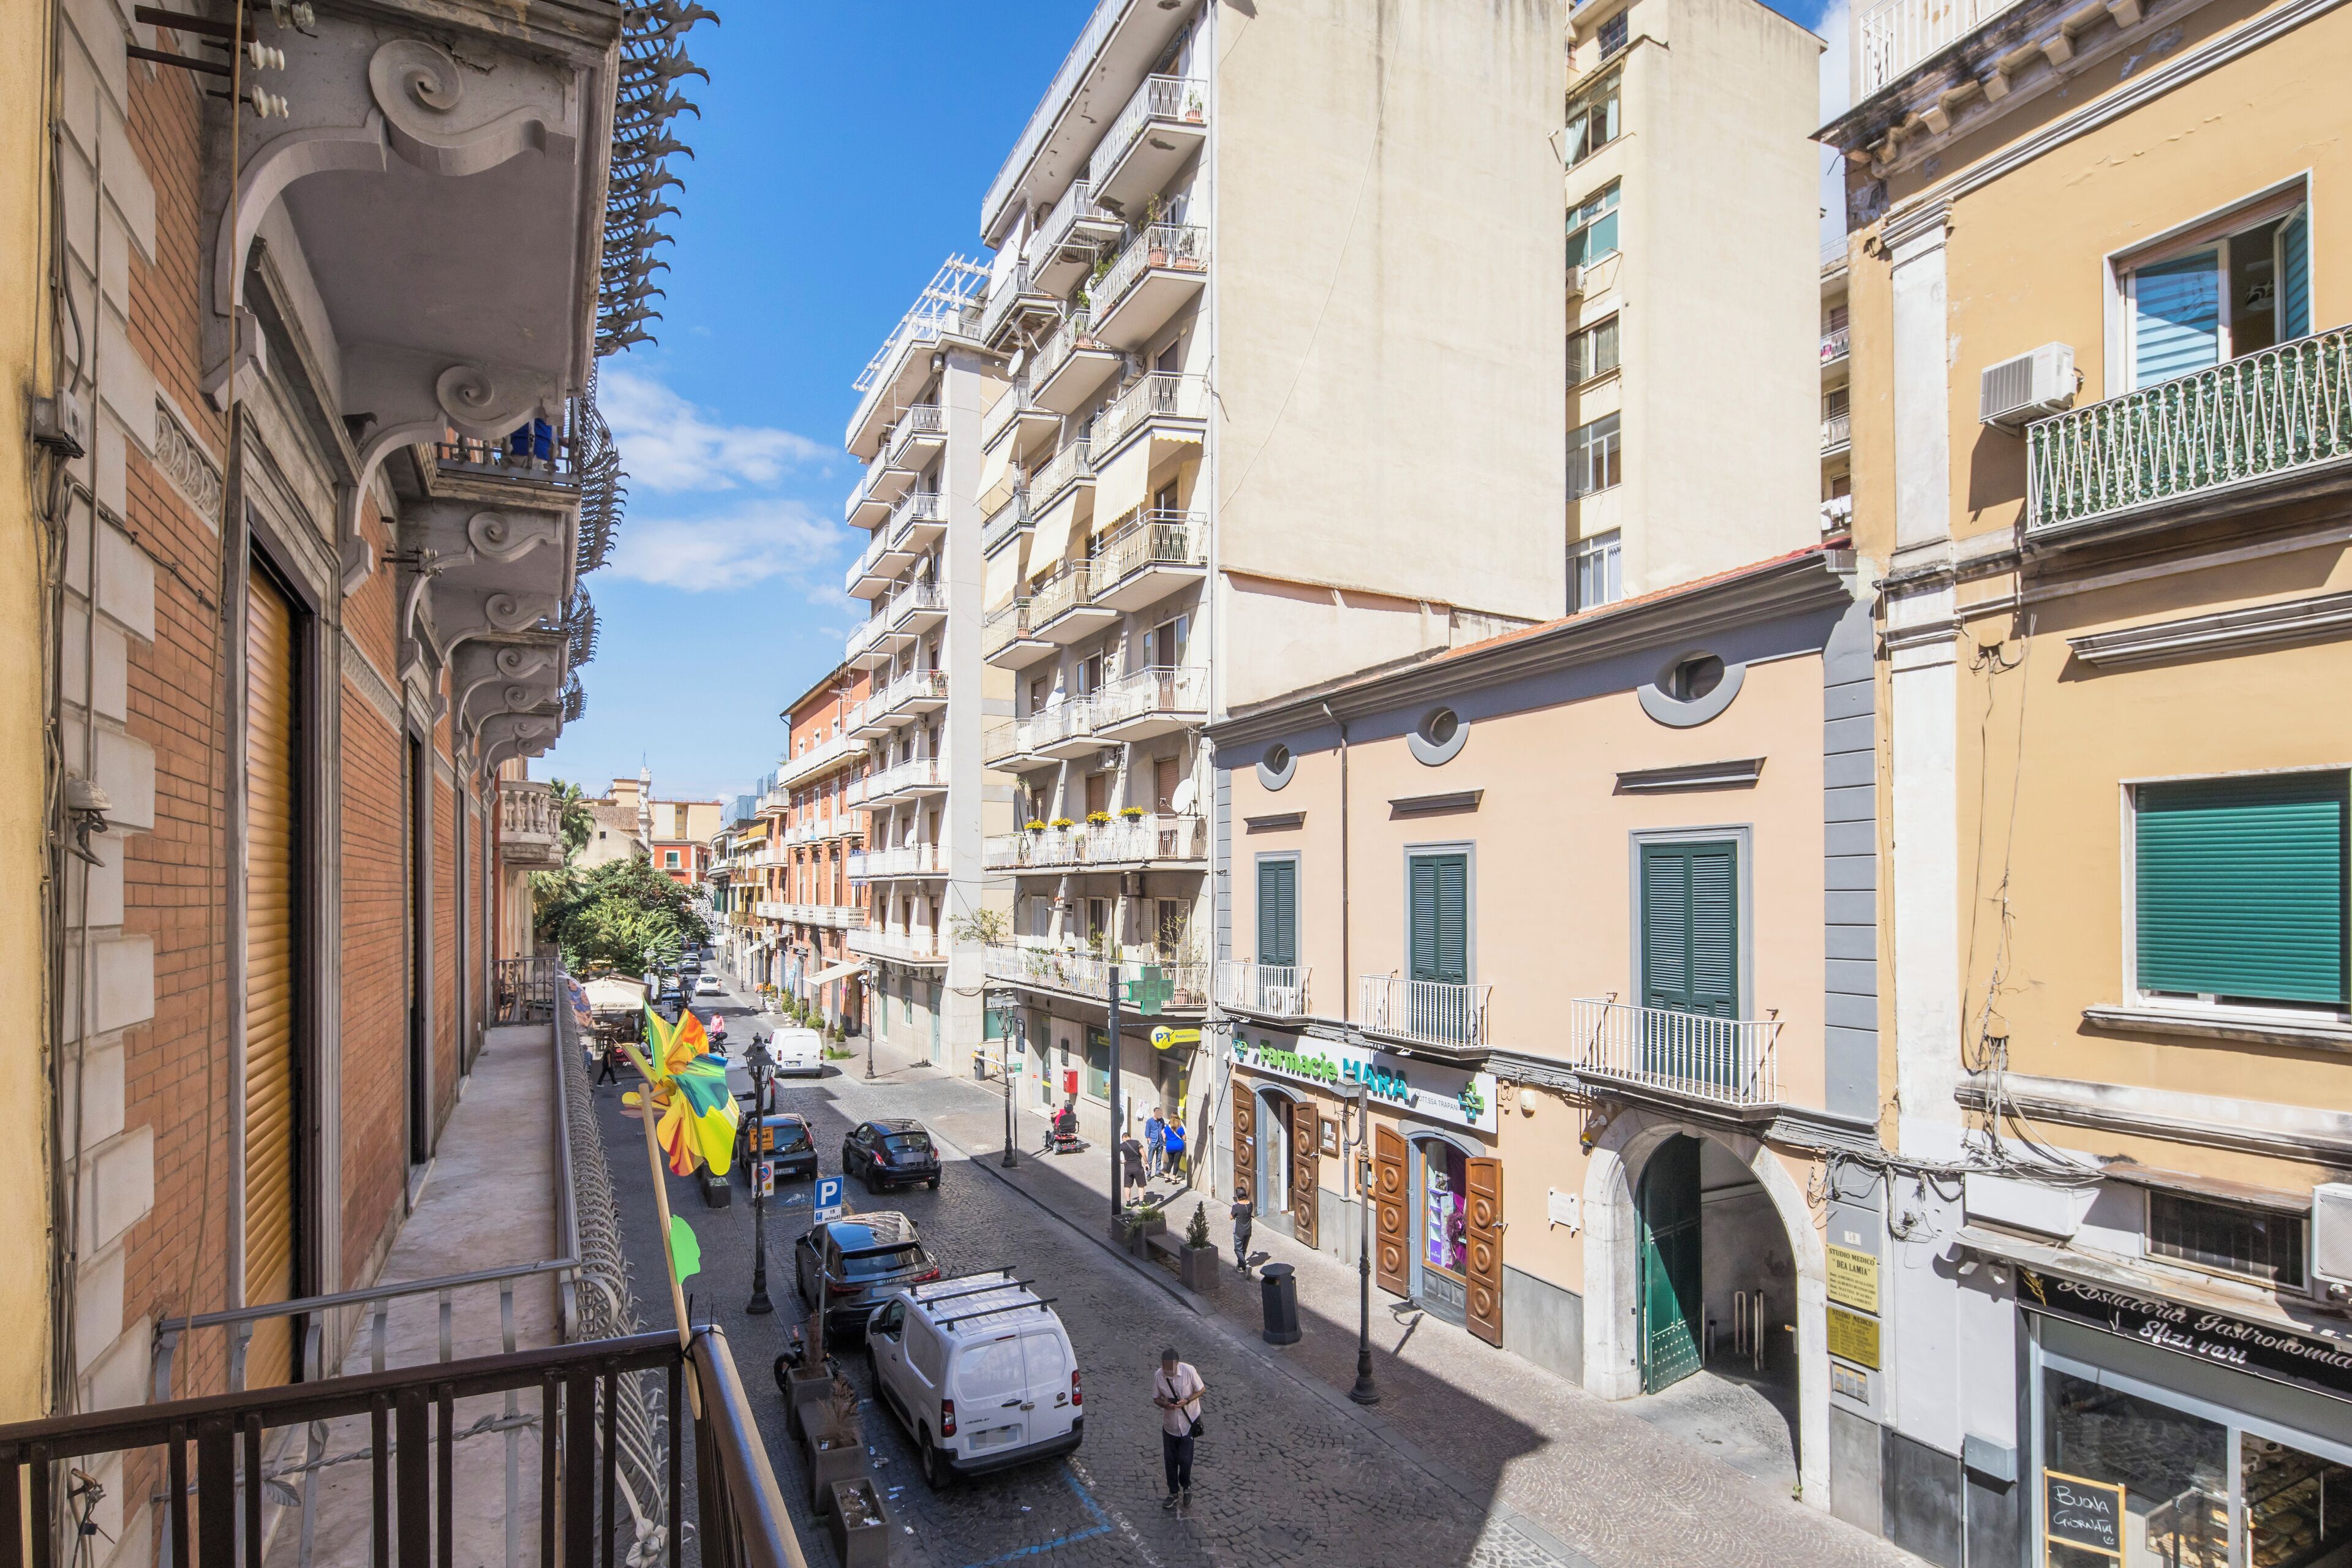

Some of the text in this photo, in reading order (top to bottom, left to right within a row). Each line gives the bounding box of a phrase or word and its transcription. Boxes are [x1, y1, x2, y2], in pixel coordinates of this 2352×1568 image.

[1155, 1032, 1170, 1042] PT
[1259, 1039, 1338, 1081] Farmacie
[1343, 1058, 1409, 1100] MARA
[1438, 1100, 1459, 1112] TRAPANI
[820, 1181, 838, 1205] P
[824, 1213, 841, 1222] minuti
[1829, 1248, 1875, 1266] STUDIO MEDICO
[1831, 1308, 1850, 1320] STUDIO
[1853, 1315, 1873, 1327] MEDICO
[2057, 1283, 2352, 1369] Rosticceria Gastronomia
[2139, 1320, 2248, 1364] Sfizi vari
[2052, 1485, 2110, 1514] BUONA
